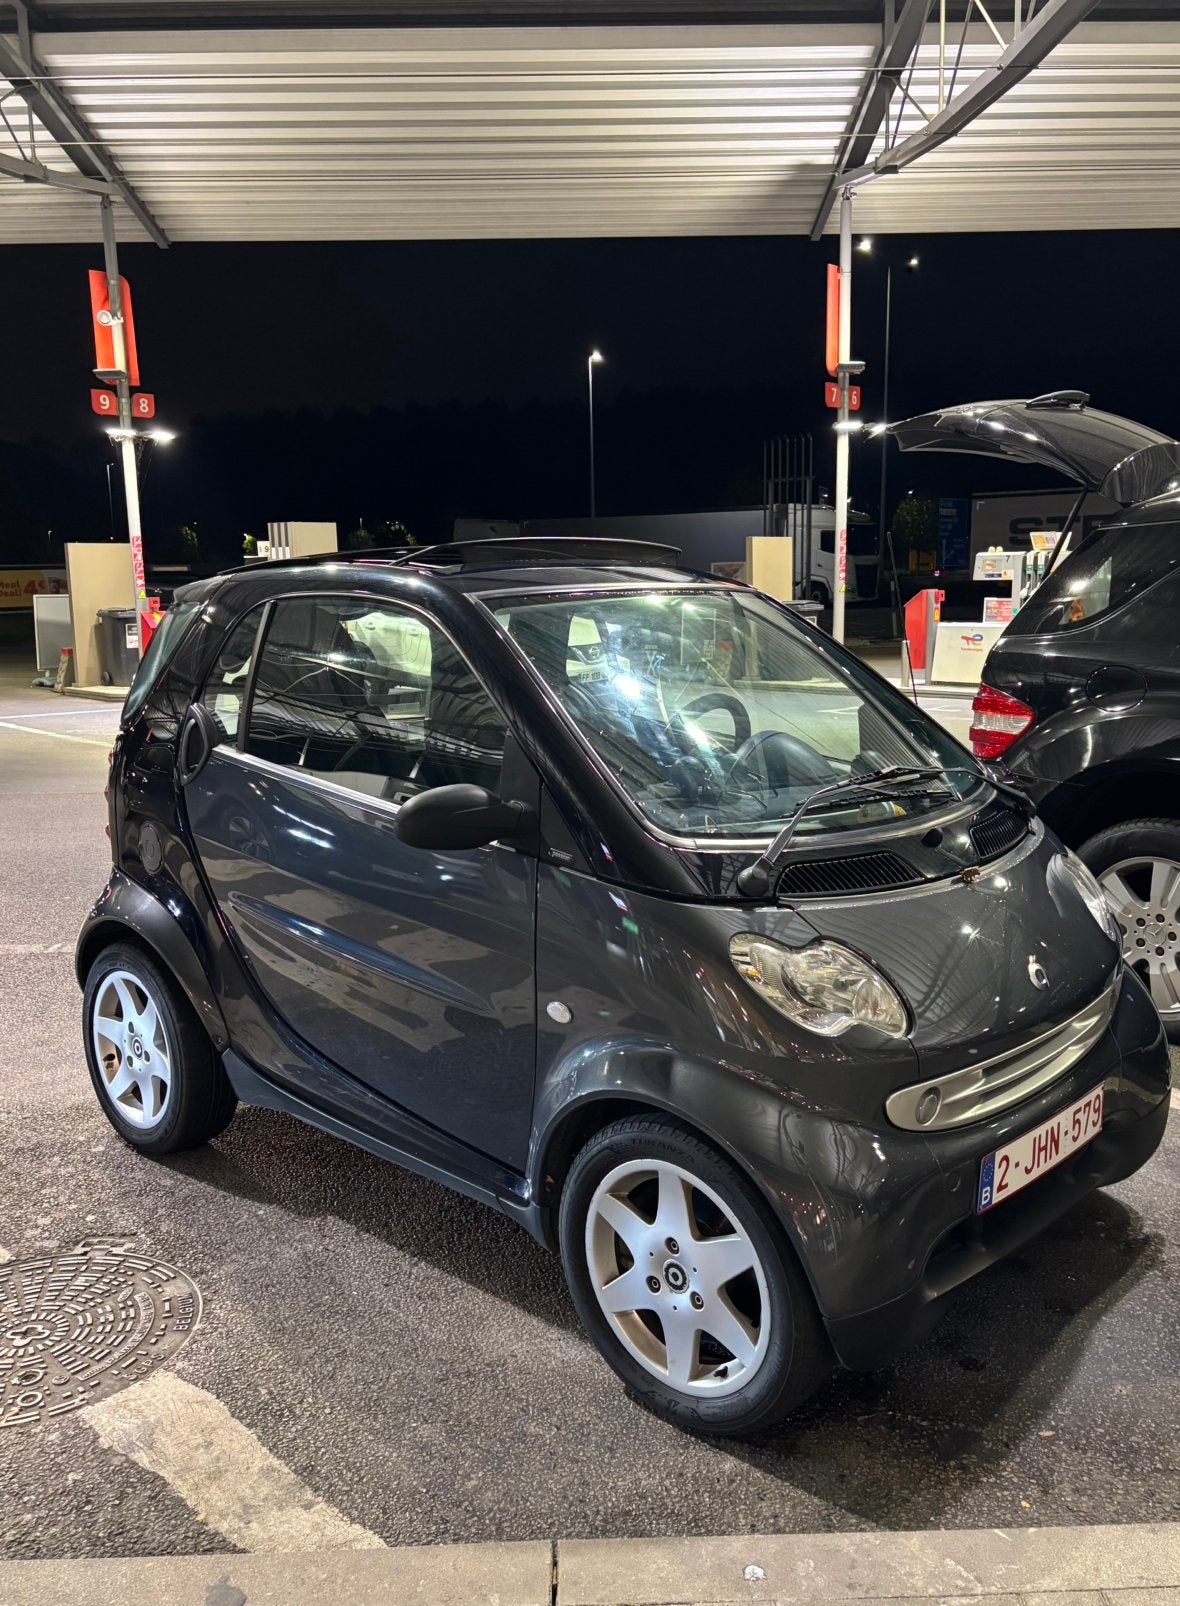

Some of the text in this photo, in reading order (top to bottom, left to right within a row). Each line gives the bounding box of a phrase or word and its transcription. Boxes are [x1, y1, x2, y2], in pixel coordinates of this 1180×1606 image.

[99, 394, 110, 410] 9
[831, 388, 837, 402] 7
[852, 391, 857, 405] 6
[139, 397, 149, 413] 8
[996, 1093, 1102, 1194] 2-JHN-579
[981, 1186, 991, 1206] B
[173, 1291, 195, 1331] BELGIUM
